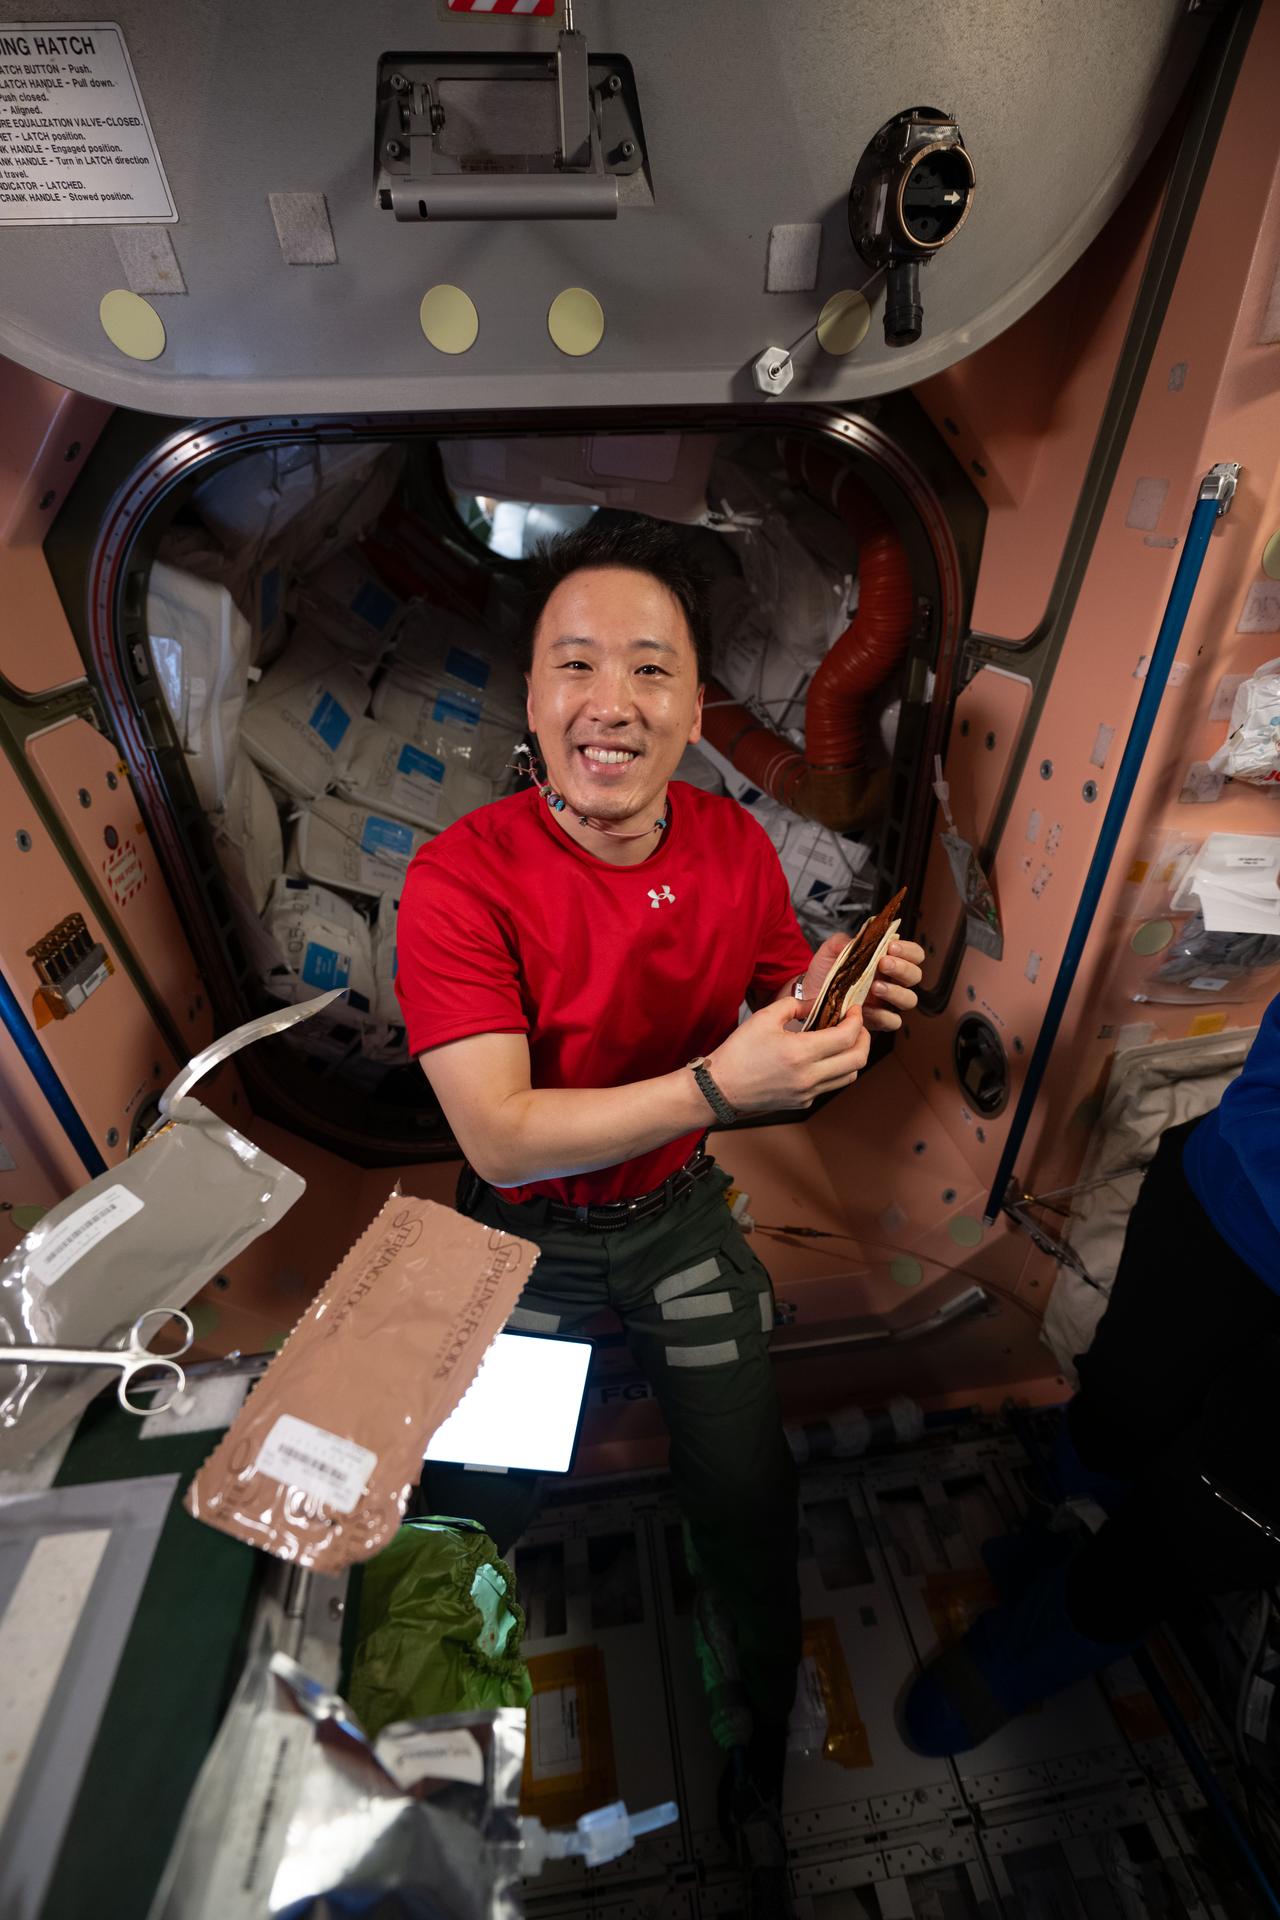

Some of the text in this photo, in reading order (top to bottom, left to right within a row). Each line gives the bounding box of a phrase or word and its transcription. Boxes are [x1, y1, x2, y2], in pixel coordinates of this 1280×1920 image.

[0, 36, 95, 55] ING HATCH
[24, 64, 60, 74] BUTTON
[68, 64, 92, 74] Push.
[0, 79, 27, 88] LATCH
[29, 79, 64, 88] HANDLE
[72, 78, 88, 87] Pull
[90, 79, 115, 88] down.
[19, 92, 49, 101] closed.
[10, 105, 43, 116] Aligned.
[0, 119, 12, 128] RE
[13, 118, 73, 128] EQUALIZATION
[21, 131, 50, 141] LATCH
[51, 131, 86, 142] position.
[10, 144, 43, 153] HANDLE
[51, 144, 86, 154] Engaged
[88, 144, 122, 154] position.
[14, 157, 48, 166] HANDLE
[55, 156, 74, 165] Turn
[76, 156, 83, 165] in
[84, 156, 113, 165] LATCH
[115, 156, 150, 165] direction
[45, 181, 86, 190] LATCHED.
[0, 193, 27, 202] CRANK
[28, 193, 61, 202] HANDLE
[68, 192, 99, 201] Stowed
[100, 192, 134, 202] position.
[364, 1210, 423, 1281] STERLING
[433, 1231, 522, 1380] STERLING FOODS
